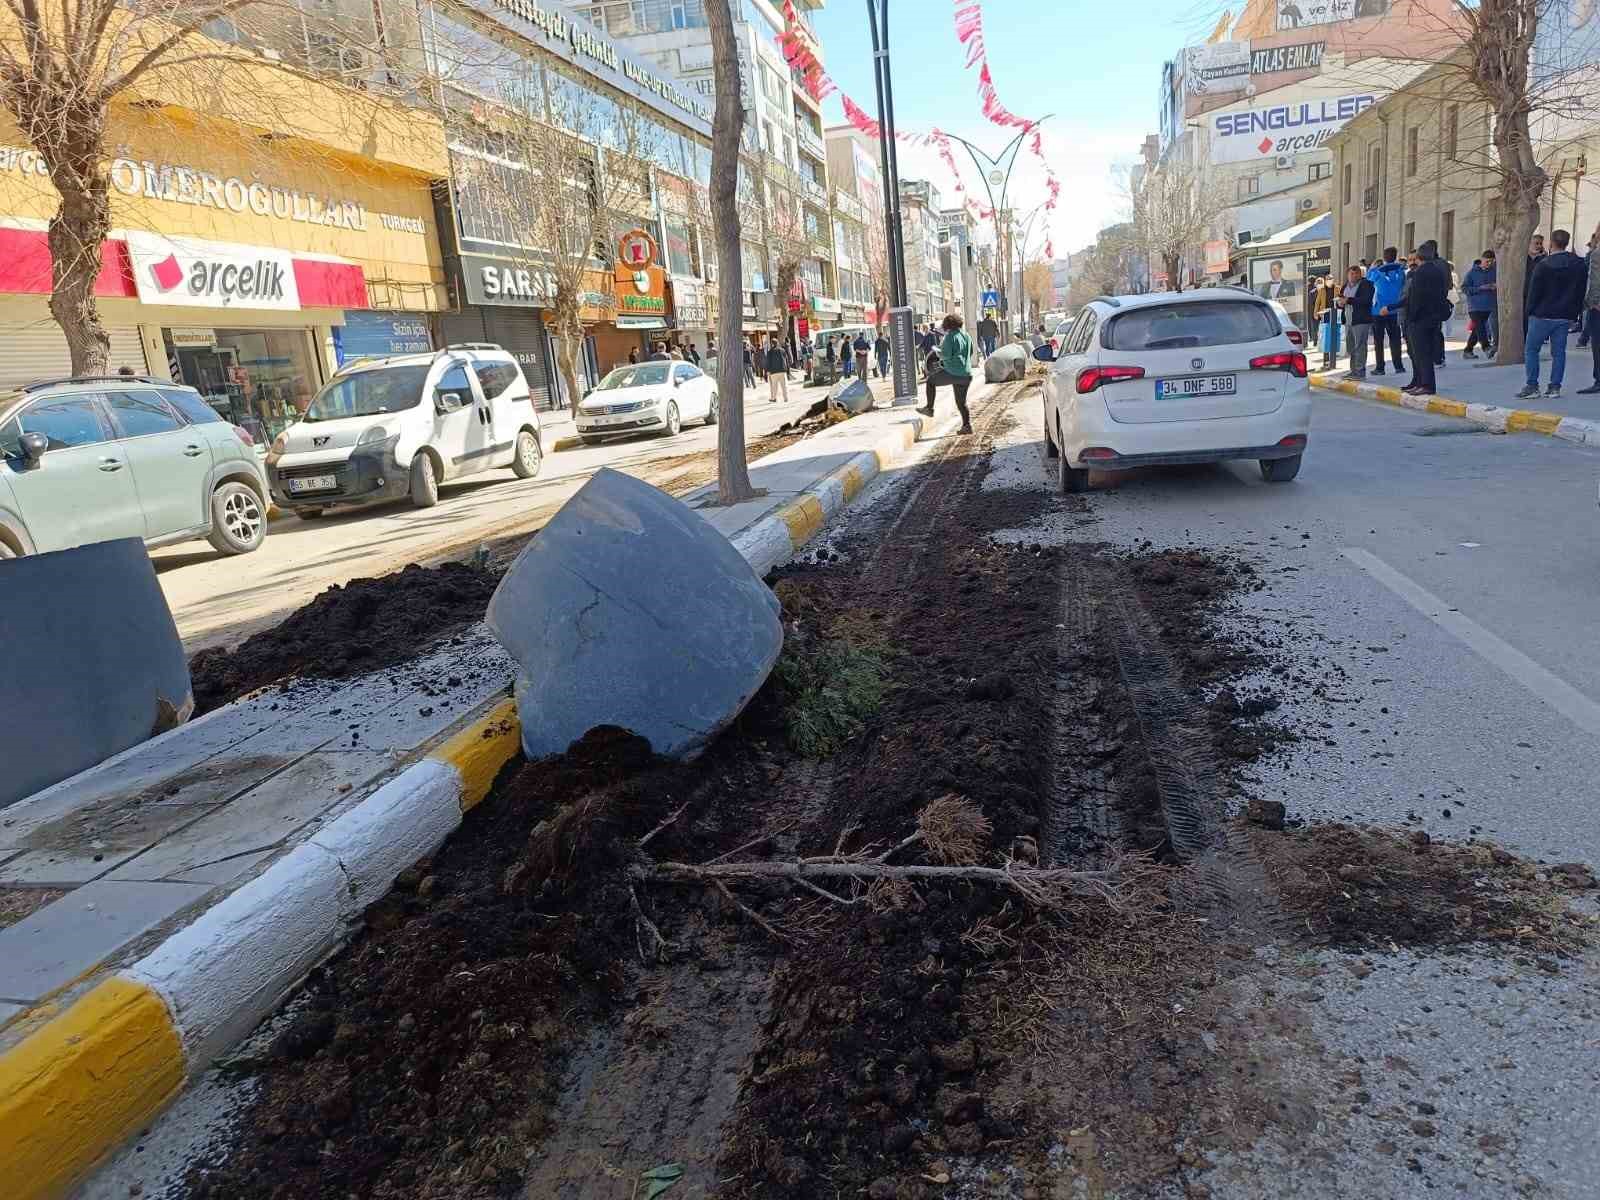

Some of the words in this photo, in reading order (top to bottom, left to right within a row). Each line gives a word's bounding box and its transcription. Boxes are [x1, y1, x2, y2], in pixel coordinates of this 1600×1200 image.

[1253, 48, 1286, 74] ATLAS
[1287, 43, 1326, 69] EMLAK
[189, 258, 285, 306] arçelik
[1163, 381, 1178, 394] 34
[1184, 379, 1205, 393] DNF
[1211, 377, 1233, 391] 588
